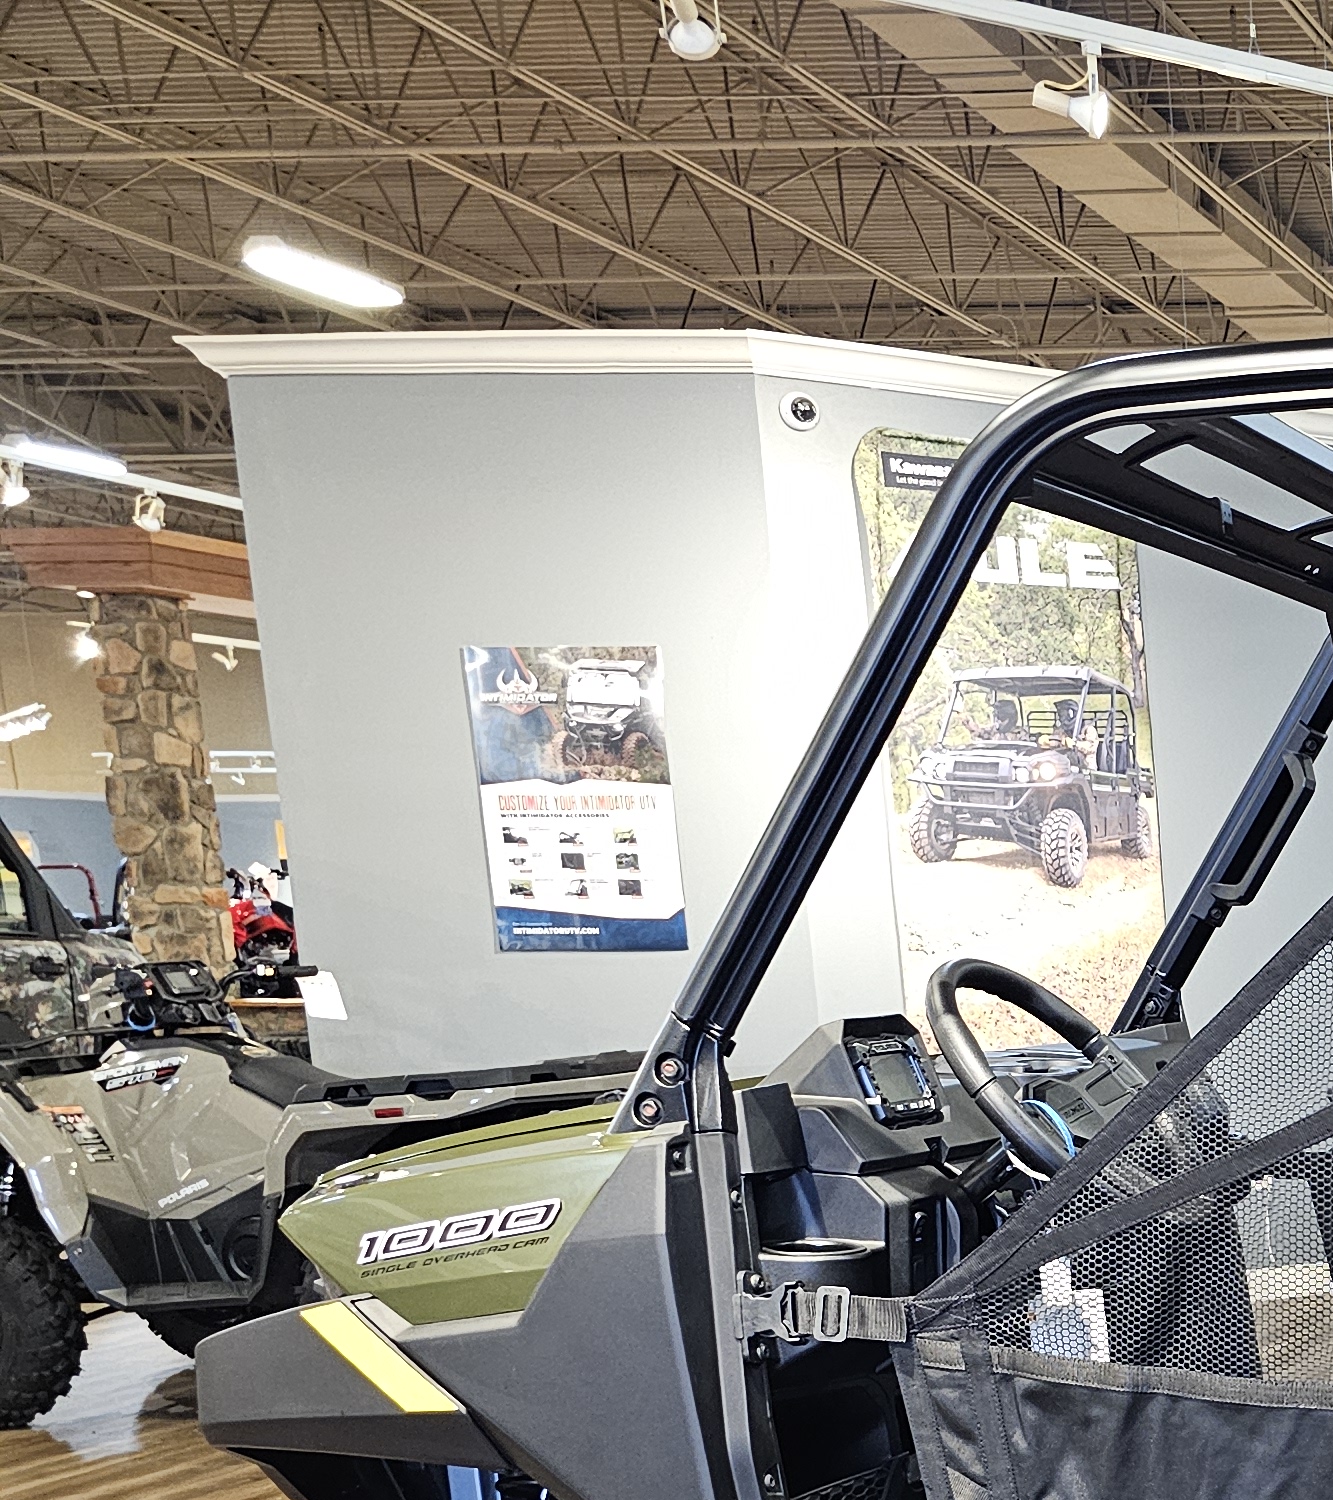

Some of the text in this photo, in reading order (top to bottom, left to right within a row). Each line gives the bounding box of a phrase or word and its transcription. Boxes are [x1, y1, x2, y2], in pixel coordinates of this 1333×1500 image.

[889, 457, 953, 478] Kawasa
[888, 536, 1121, 590] ULE
[480, 692, 558, 704] INTIMIDATOR
[498, 795, 656, 811] CUSTOMIZE YOUR INTIMIDATOR UTV
[512, 927, 600, 935] INTIMIDATORUTV.COM
[158, 1178, 210, 1209] POLARIS
[356, 1198, 563, 1266] 1000
[360, 1236, 550, 1279] SINGLE OVERHEAD CAM
